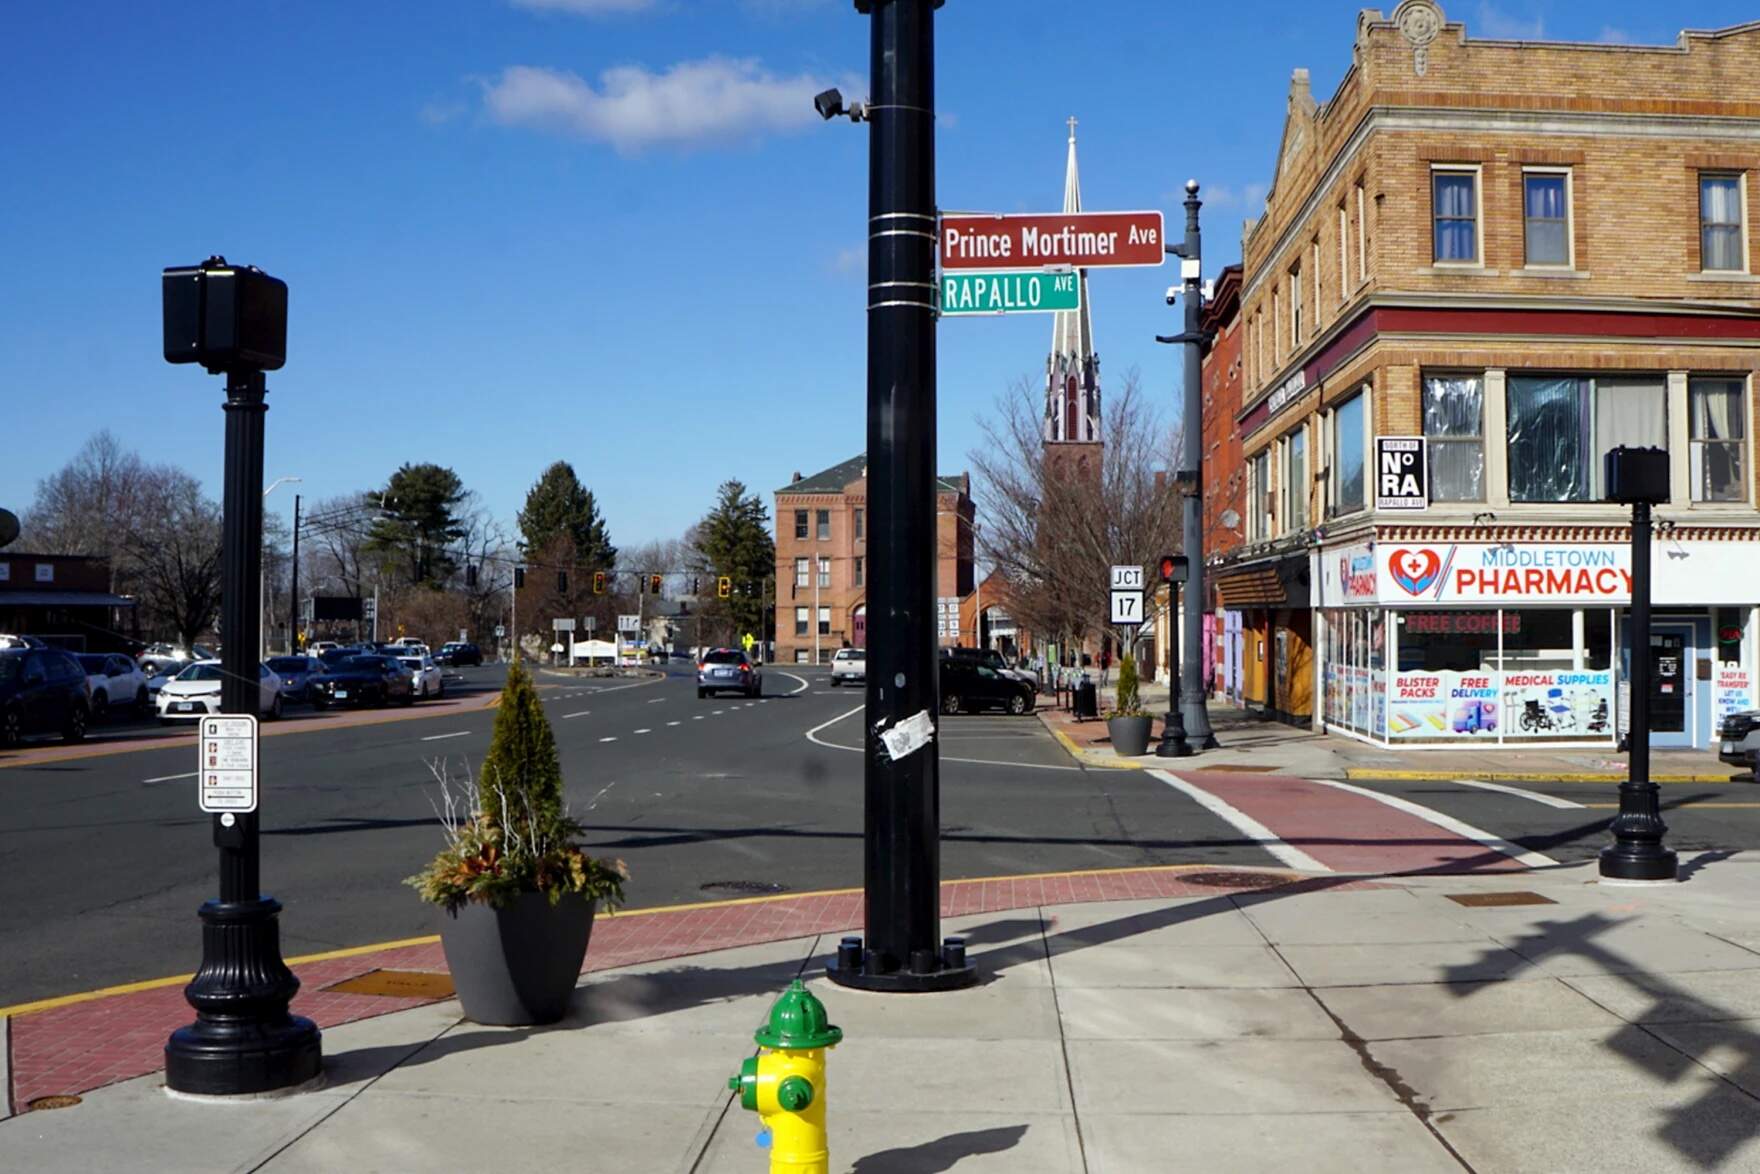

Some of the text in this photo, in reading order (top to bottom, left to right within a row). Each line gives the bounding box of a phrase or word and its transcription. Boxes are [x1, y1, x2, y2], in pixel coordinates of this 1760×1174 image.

[945, 224, 1157, 258] Prince Mortimer Ave
[945, 275, 1073, 308] RAPALLO AVE
[1382, 474, 1420, 496] RA
[1482, 551, 1615, 566] MIDDLETOWN
[1114, 570, 1140, 585] JCT
[1456, 569, 1632, 594] PHARMACY
[1119, 597, 1136, 616] 17
[1407, 614, 1520, 632] FREE COFFEE
[1396, 677, 1439, 687] BLISTER
[1460, 678, 1489, 688] FREE
[1505, 674, 1608, 686] MEDICAL SUPPLIES
[1400, 688, 1435, 698] PACKS
[1451, 688, 1498, 698] DELIVERY
